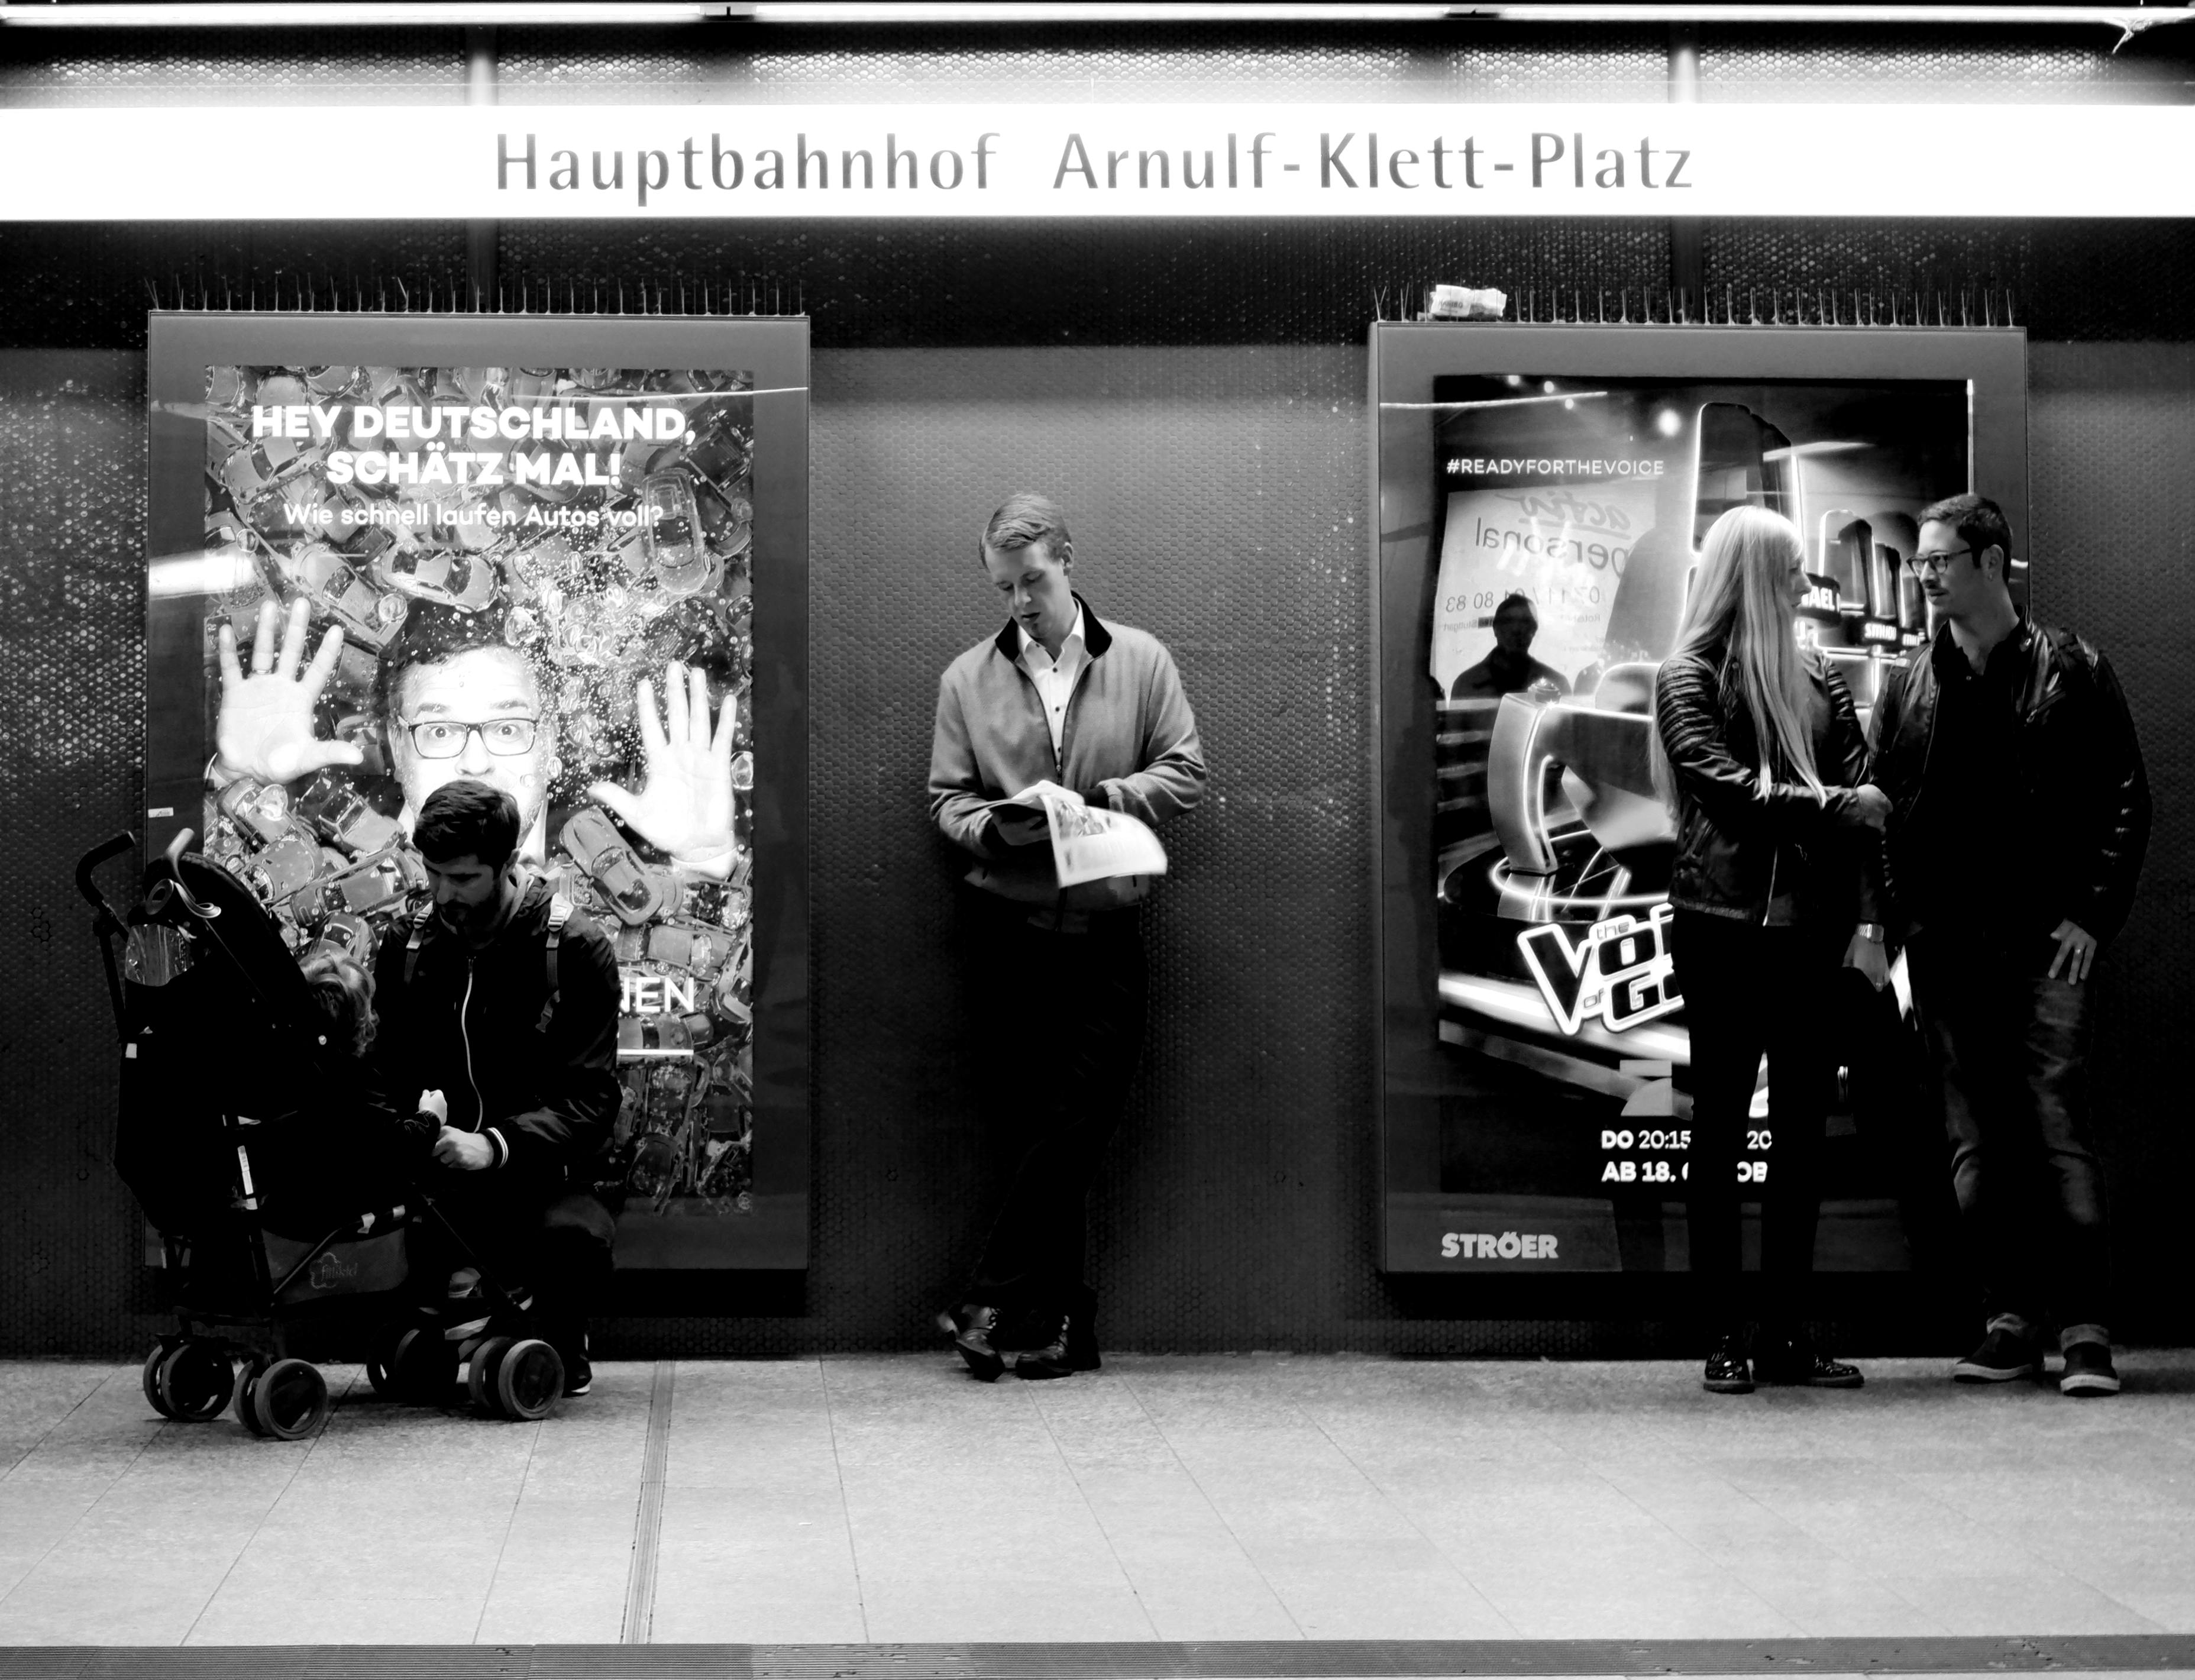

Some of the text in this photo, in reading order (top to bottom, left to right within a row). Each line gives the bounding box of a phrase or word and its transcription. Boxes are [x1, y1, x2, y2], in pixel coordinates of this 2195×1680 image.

[497, 132, 1692, 208] Hauptbahnhof Arnulf-Klett-Platz
[253, 405, 696, 445] HEY DEUTSCHLAND,
[326, 441, 620, 485] SCHÄTZ MAL!
[1446, 458, 1665, 474] #READYFORTHEVOICE
[284, 503, 664, 526] Wie schnell laufen Autos voll?
[1596, 921, 1630, 939] the
[1583, 987, 1605, 1009] of
[1601, 1130, 1634, 1149] DO
[1638, 1130, 1692, 1149] 20:15
[1601, 1161, 1637, 1182] AB
[1642, 1161, 1676, 1183] 18.
[1441, 1231, 1559, 1259] STRÖER
